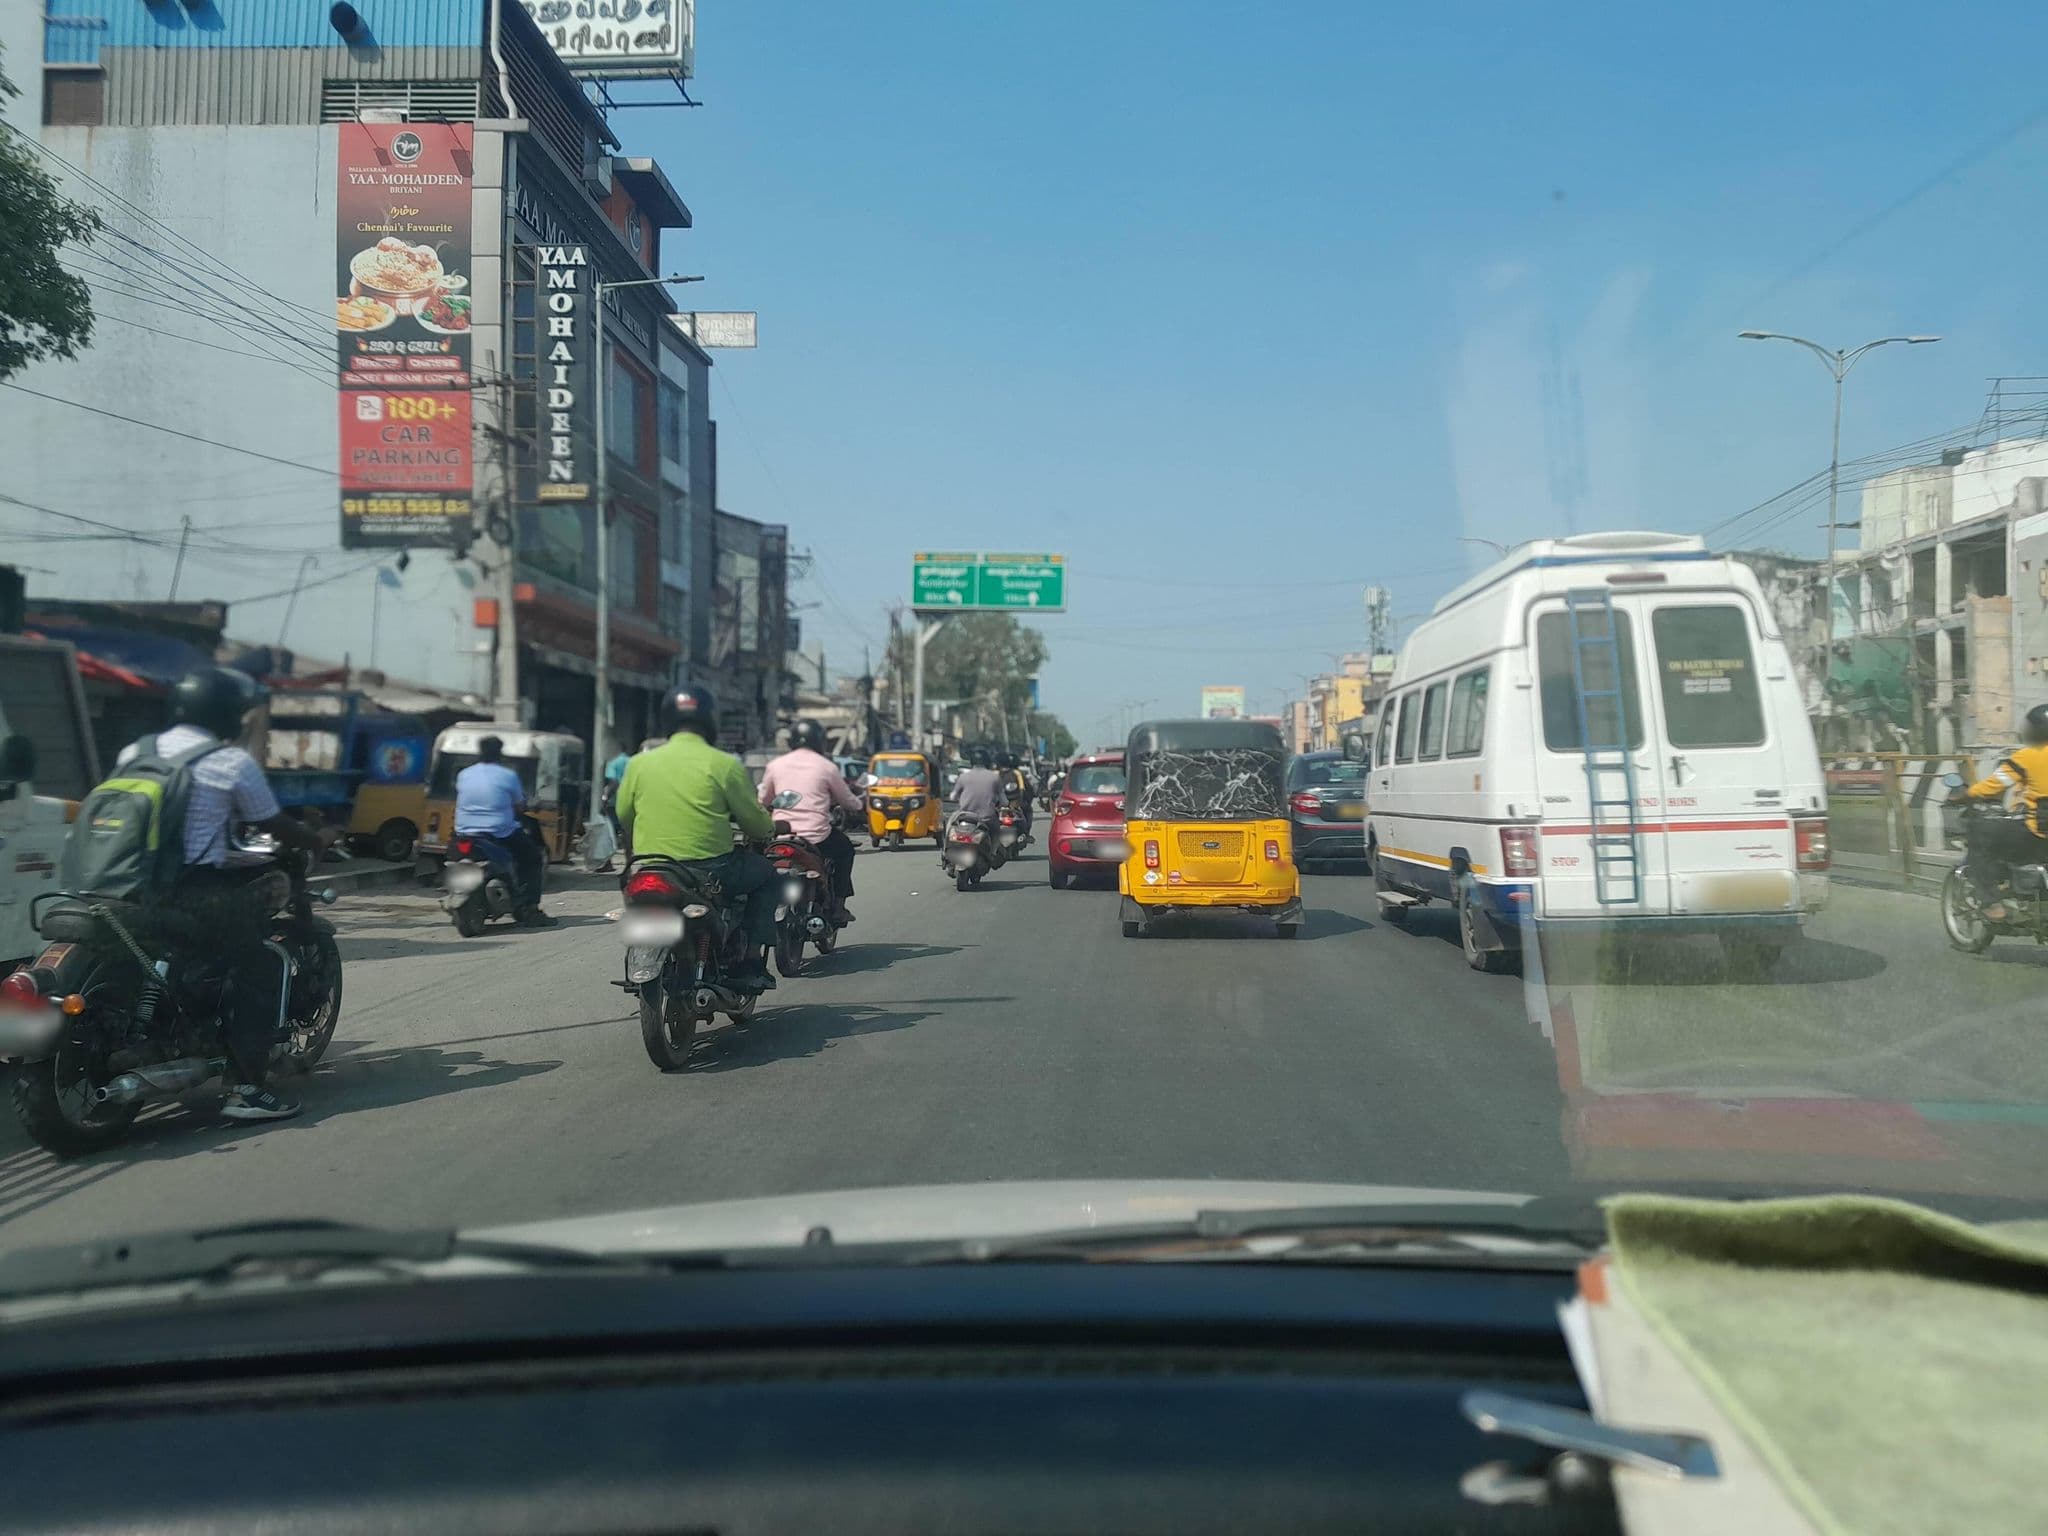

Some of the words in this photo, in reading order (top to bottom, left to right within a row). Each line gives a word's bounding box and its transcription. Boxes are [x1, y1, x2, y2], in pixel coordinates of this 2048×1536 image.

[349, 173, 378, 185] YAA.
[382, 173, 463, 185] MOHAIDEEN
[390, 186, 422, 194] BRIYANI
[390, 204, 419, 219] நம்ம
[357, 222, 404, 232] Chennai's
[407, 222, 453, 232] Favourite
[537, 247, 587, 265] YAA
[547, 269, 577, 482] MOHAIDEEN
[385, 396, 457, 420] 100+
[381, 426, 431, 443] CAR
[352, 450, 460, 466] PARKING
[1551, 856, 1579, 867] STOP
